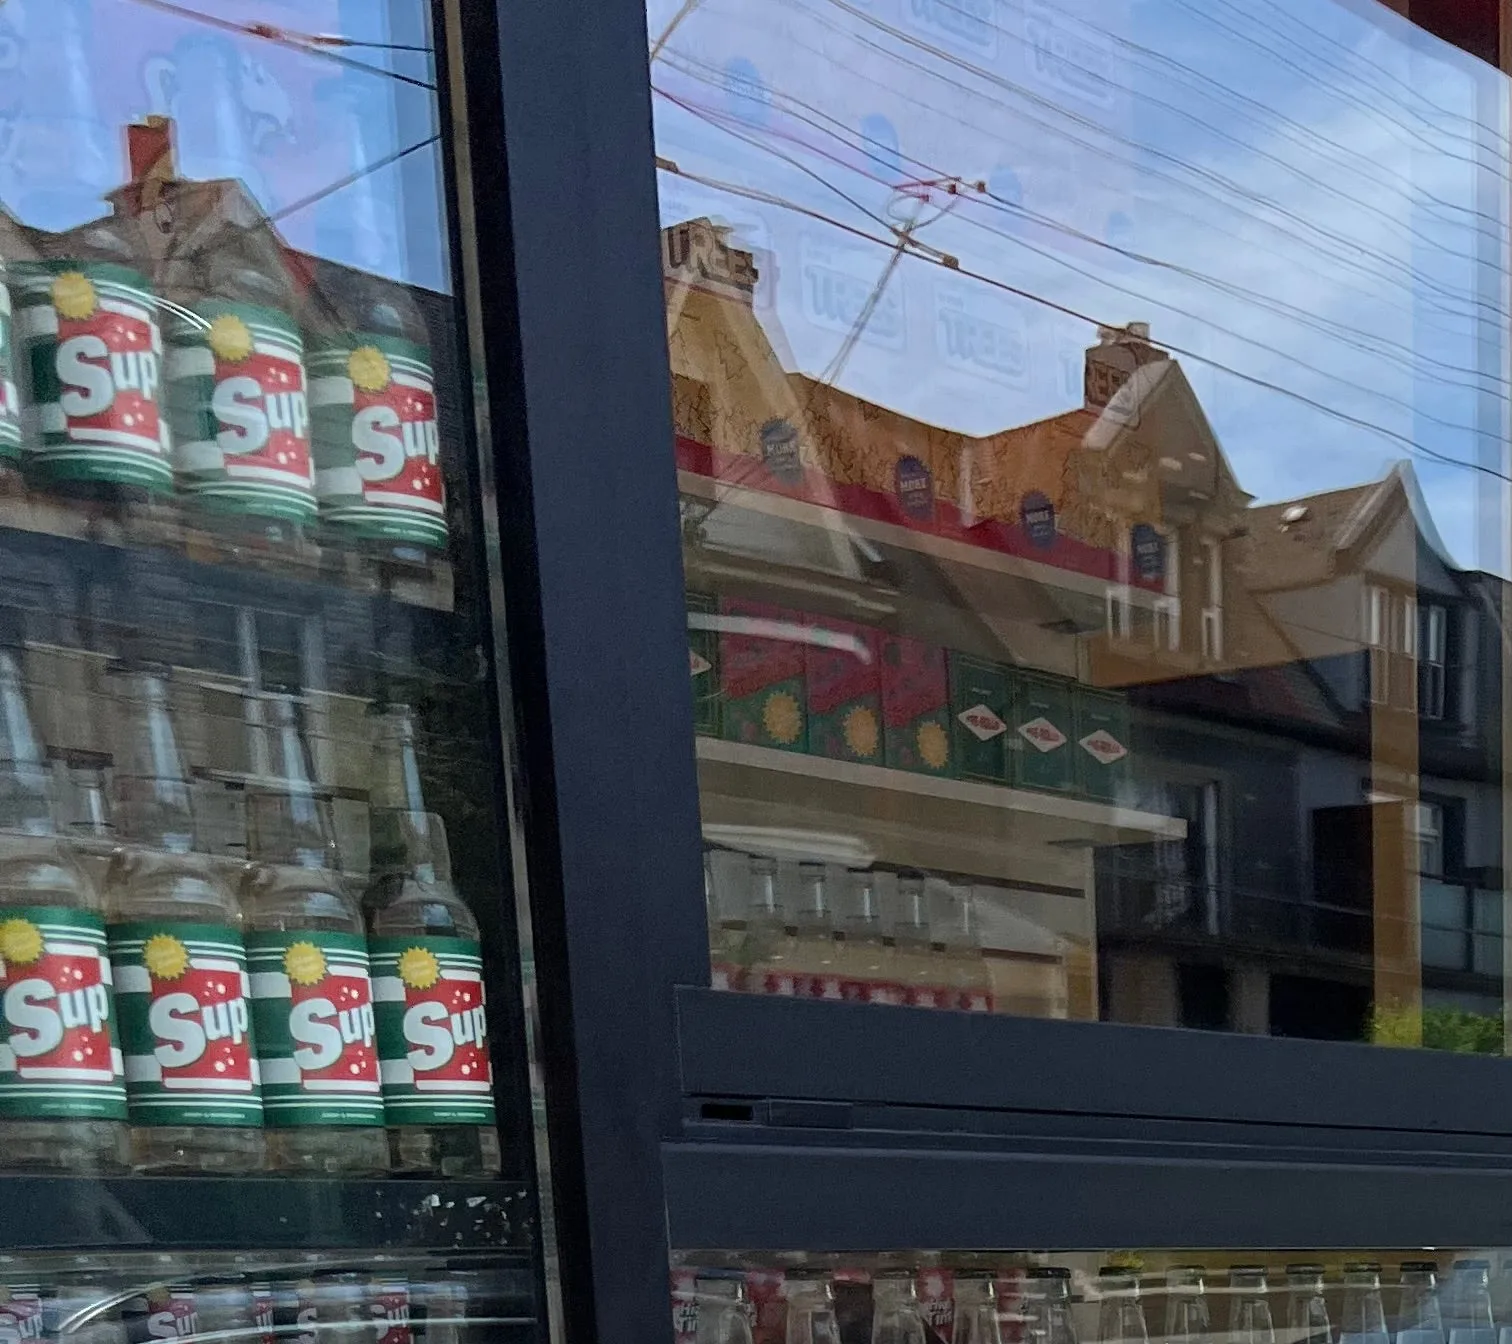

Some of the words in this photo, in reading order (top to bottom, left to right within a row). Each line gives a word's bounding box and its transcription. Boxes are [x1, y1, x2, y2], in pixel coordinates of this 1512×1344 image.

[56, 336, 157, 417] Sup
[213, 377, 308, 453] Sup
[352, 406, 438, 480] Sup
[4, 978, 108, 1057] Sup
[149, 992, 248, 1068] Sup
[289, 998, 375, 1070] Sup
[403, 1001, 487, 1071] Sup
